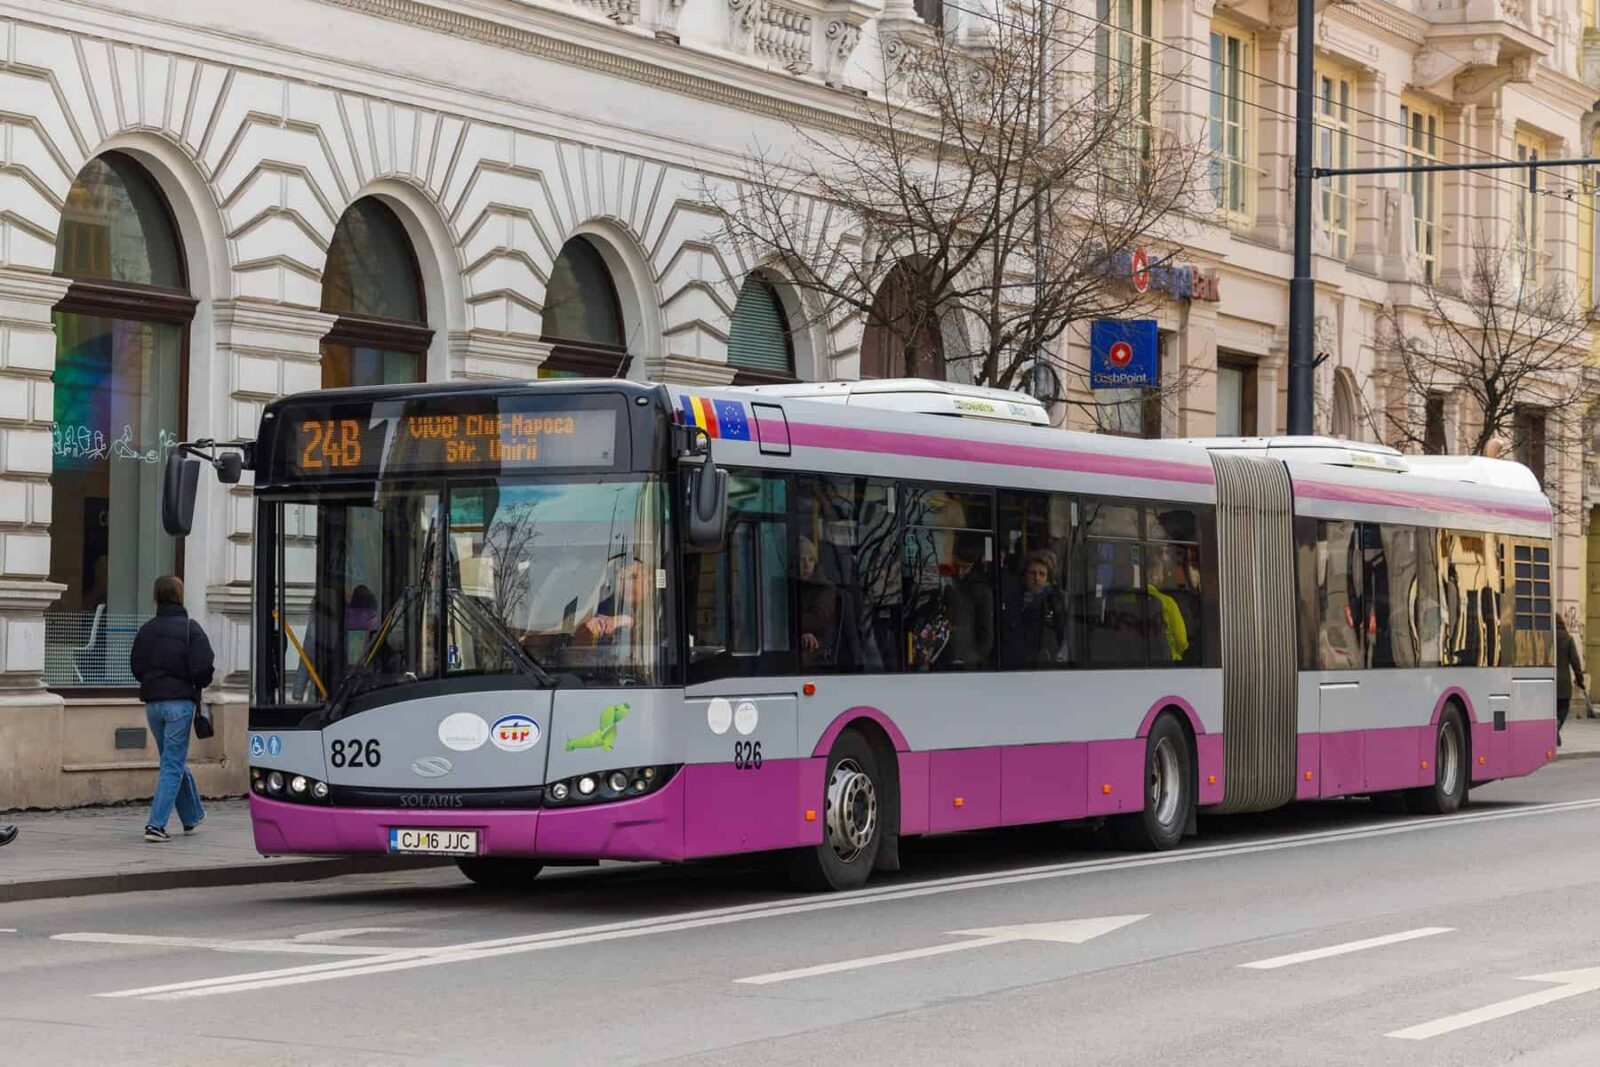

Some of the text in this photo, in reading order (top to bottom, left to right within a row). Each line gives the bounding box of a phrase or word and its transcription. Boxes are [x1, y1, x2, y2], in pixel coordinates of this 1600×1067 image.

[466, 414, 574, 436] Cluj-Napoca
[302, 420, 361, 468] 24B
[446, 438, 538, 463] Str. Unirii
[331, 739, 381, 768] 826
[734, 740, 762, 770] 826
[400, 794, 463, 807] SOLARIS
[402, 832, 421, 848] CJ
[426, 833, 440, 849] 16
[444, 833, 470, 850] JJC
